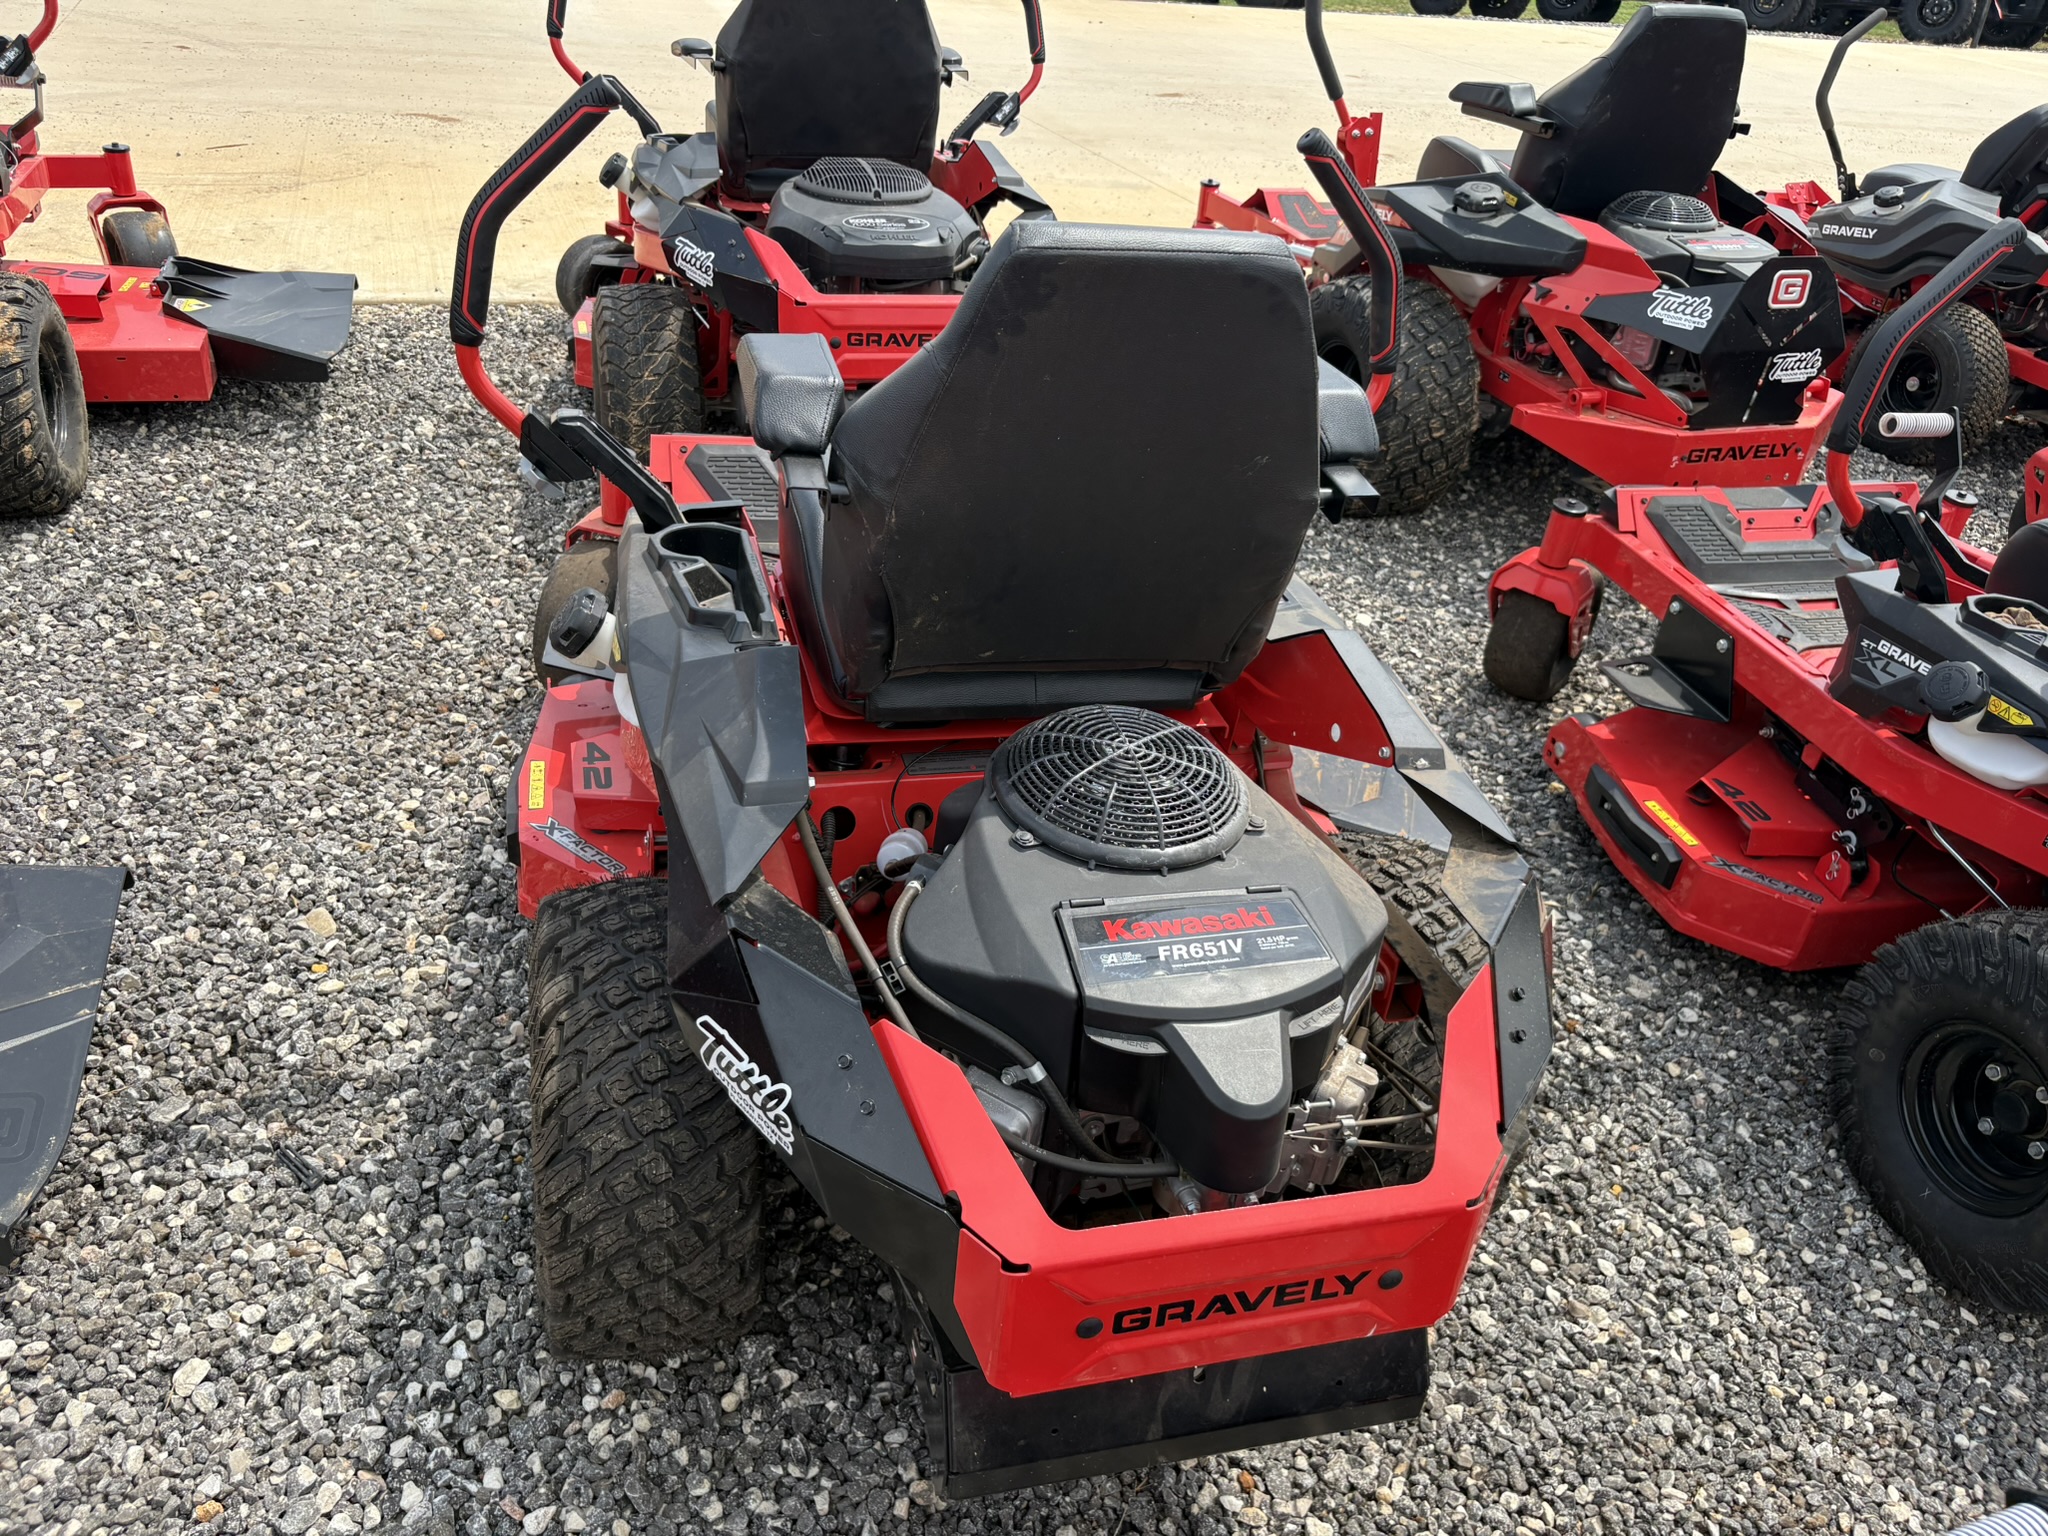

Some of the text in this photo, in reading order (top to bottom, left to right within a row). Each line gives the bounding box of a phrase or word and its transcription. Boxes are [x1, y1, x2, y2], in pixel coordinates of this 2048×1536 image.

[1822, 224, 1878, 239] GRAVELY
[675, 238, 713, 278] Tuttle
[1649, 290, 1712, 320] Tuttle
[846, 332, 940, 348] GRAVE
[1770, 349, 1820, 379] Tuttle
[1686, 442, 1797, 464] GRAVELY
[1855, 648, 1898, 679] XL
[1860, 638, 1933, 677] ZT GRAVE
[582, 742, 613, 790] 42
[1712, 778, 1772, 822] 42
[1102, 905, 1277, 942] Kawasaki
[1157, 937, 1243, 962] FR651V
[1297, 1001, 1341, 1031] LIFT HERE
[698, 1018, 792, 1139] Tuttle
[713, 1066, 791, 1151] OUTDOOR POWER
[1111, 1269, 1374, 1335] GRAVELY
